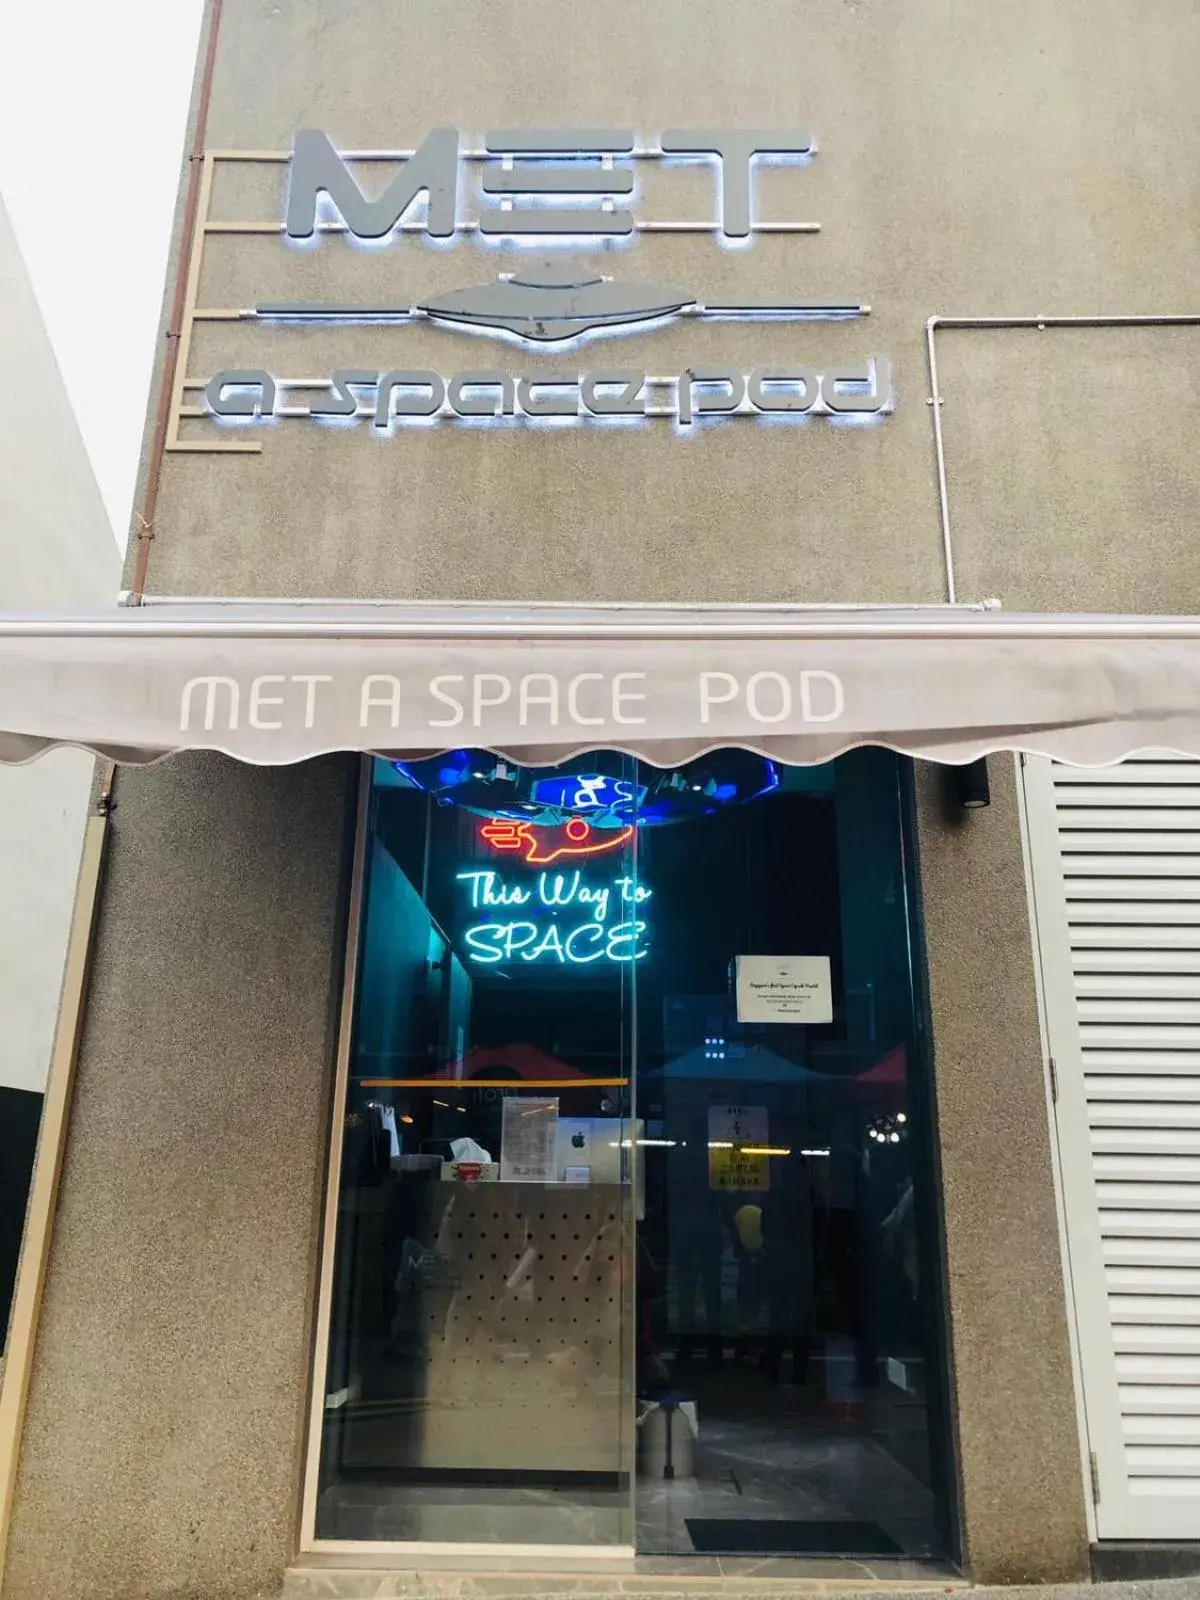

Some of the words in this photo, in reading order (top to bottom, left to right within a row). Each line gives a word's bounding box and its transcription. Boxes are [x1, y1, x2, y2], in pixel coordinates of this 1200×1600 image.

[286, 129, 811, 238] MET
[205, 369, 275, 416] a
[309, 367, 646, 427] space
[679, 358, 893, 425] pod
[179, 674, 332, 732] MET
[360, 674, 400, 728] A
[428, 672, 647, 728] SPACE
[701, 670, 846, 725] POD
[456, 870, 530, 908] This
[539, 869, 611, 920] Way
[614, 875, 652, 905] to
[464, 921, 650, 964] SPACE
